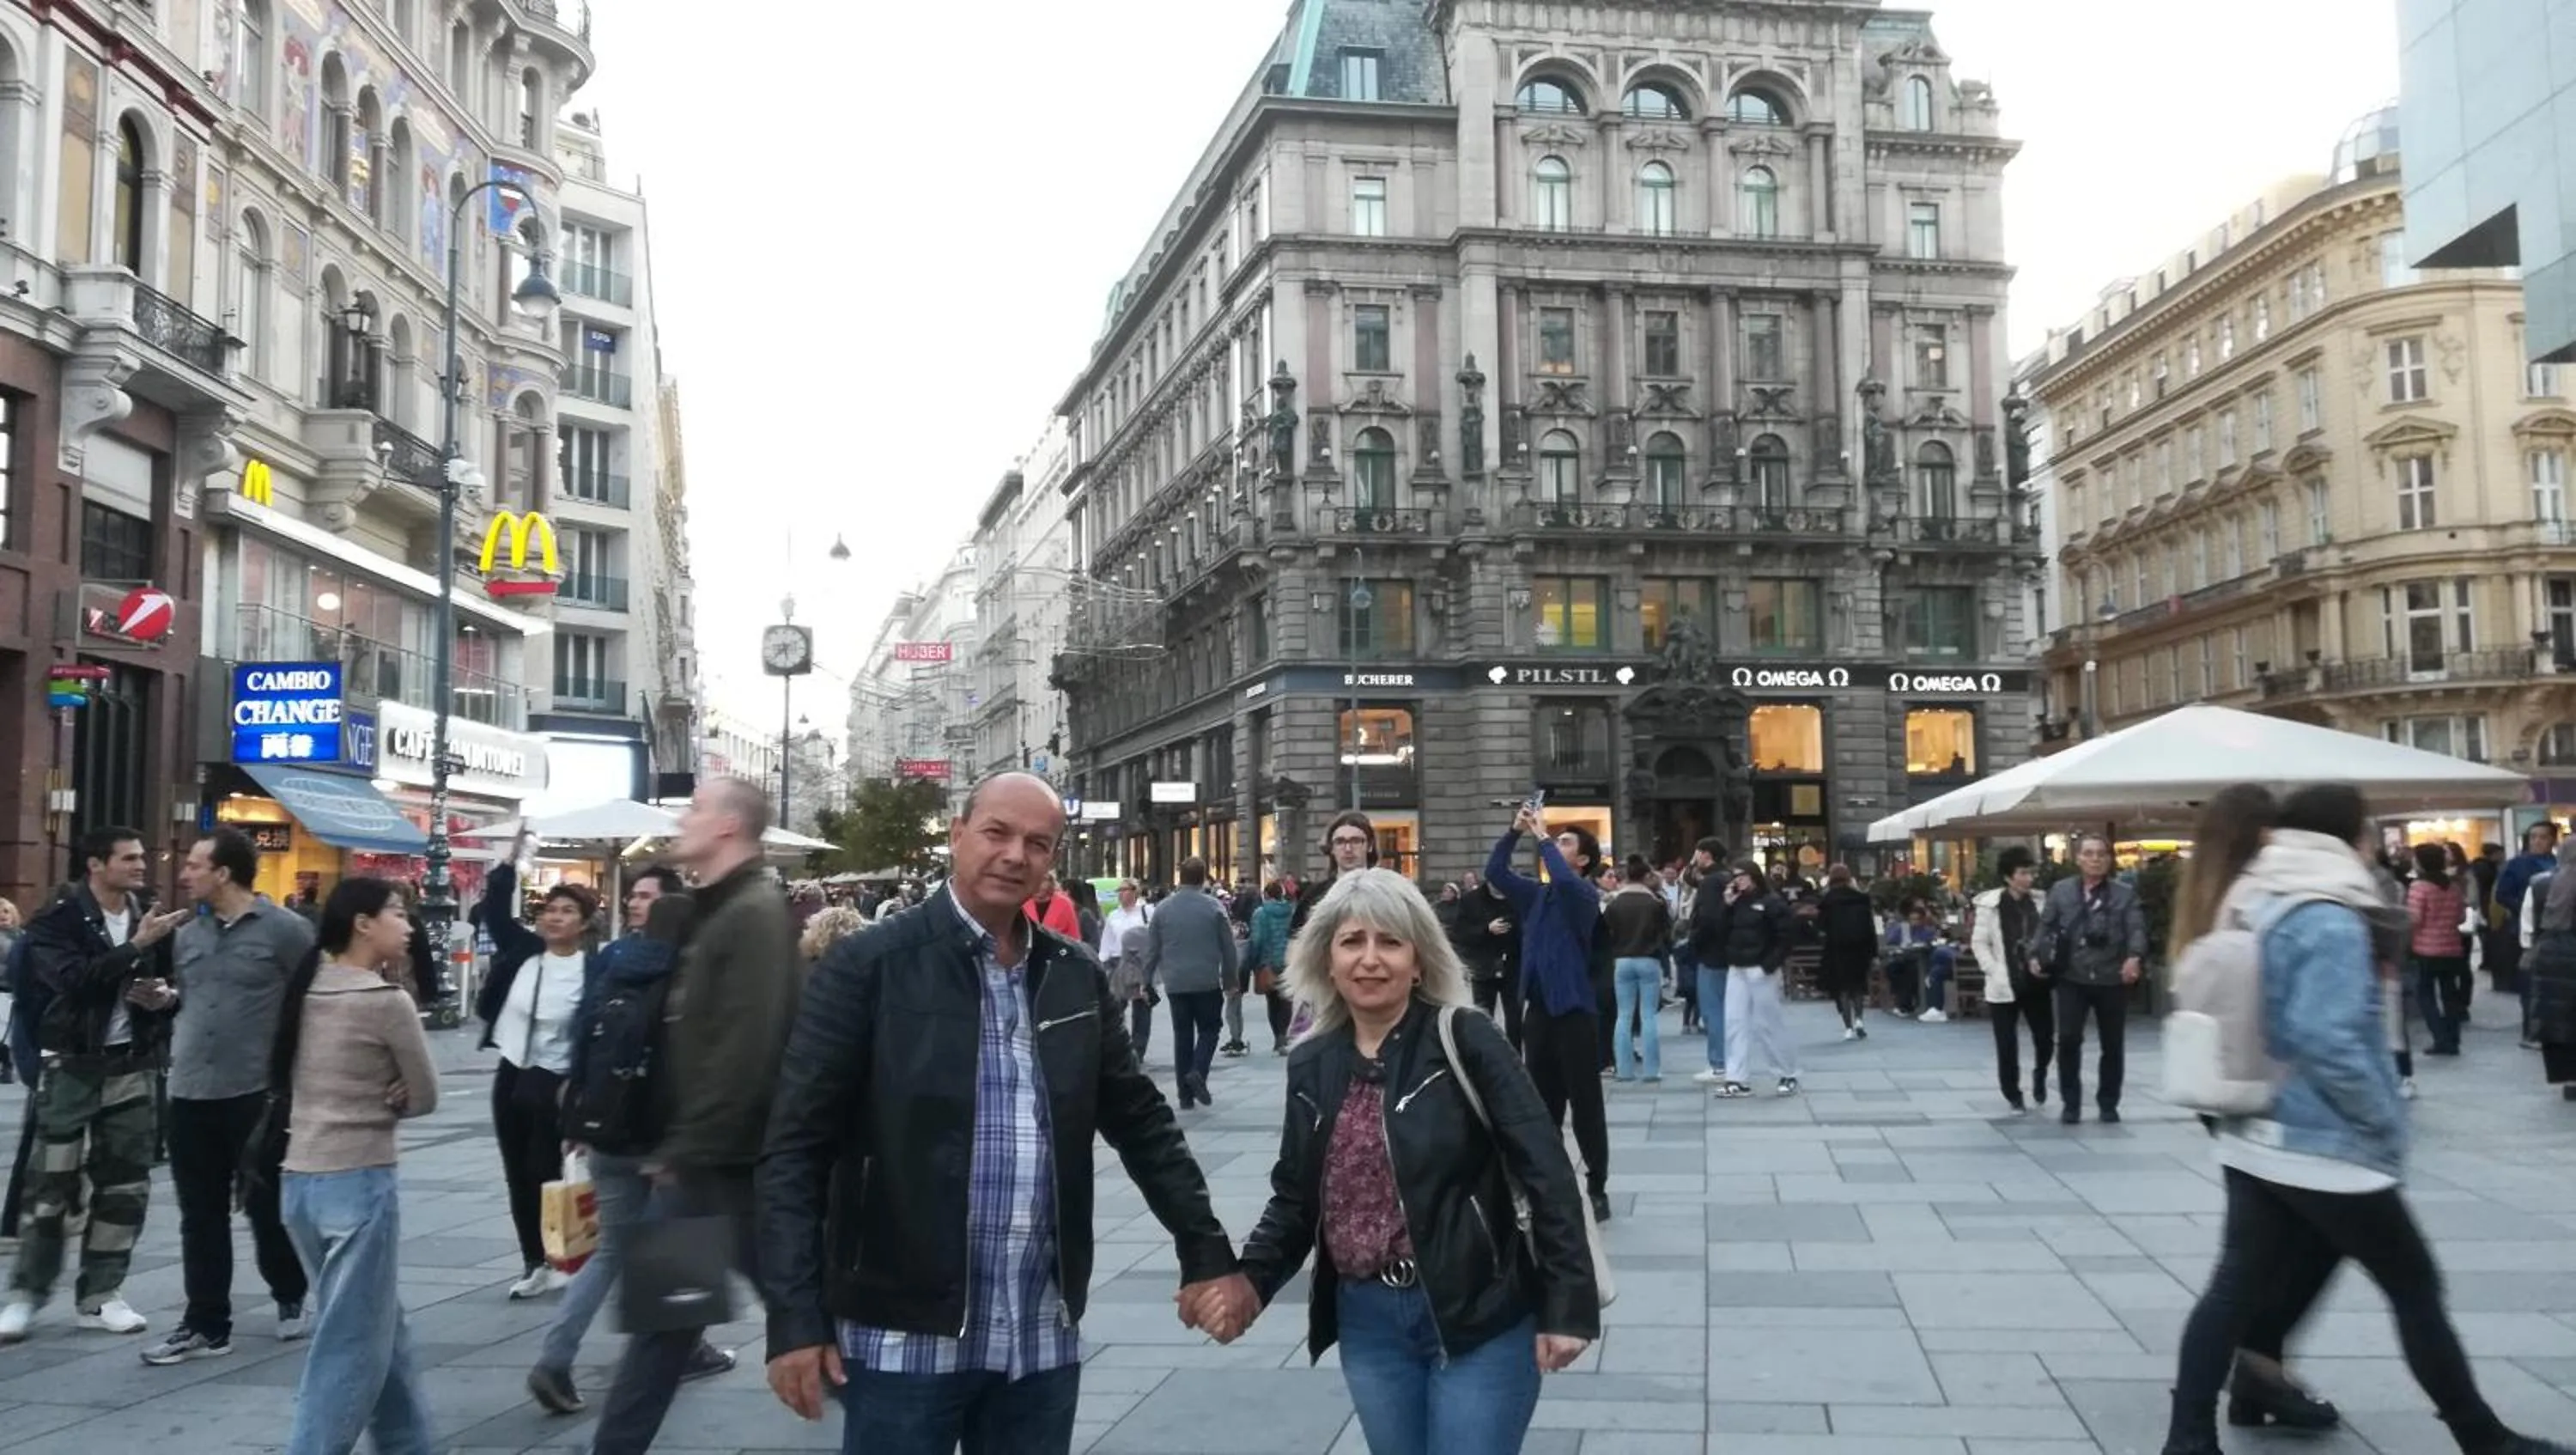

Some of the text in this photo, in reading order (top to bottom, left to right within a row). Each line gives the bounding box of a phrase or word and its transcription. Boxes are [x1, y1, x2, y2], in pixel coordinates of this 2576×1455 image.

[246, 670, 331, 691] CAMBIO
[1516, 669, 1608, 683] PILSTL
[1756, 671, 1825, 686] OMEGA
[1912, 676, 1978, 691] OMEGA
[234, 698, 342, 725] CHANGE
[1063, 799, 1079, 815] U
